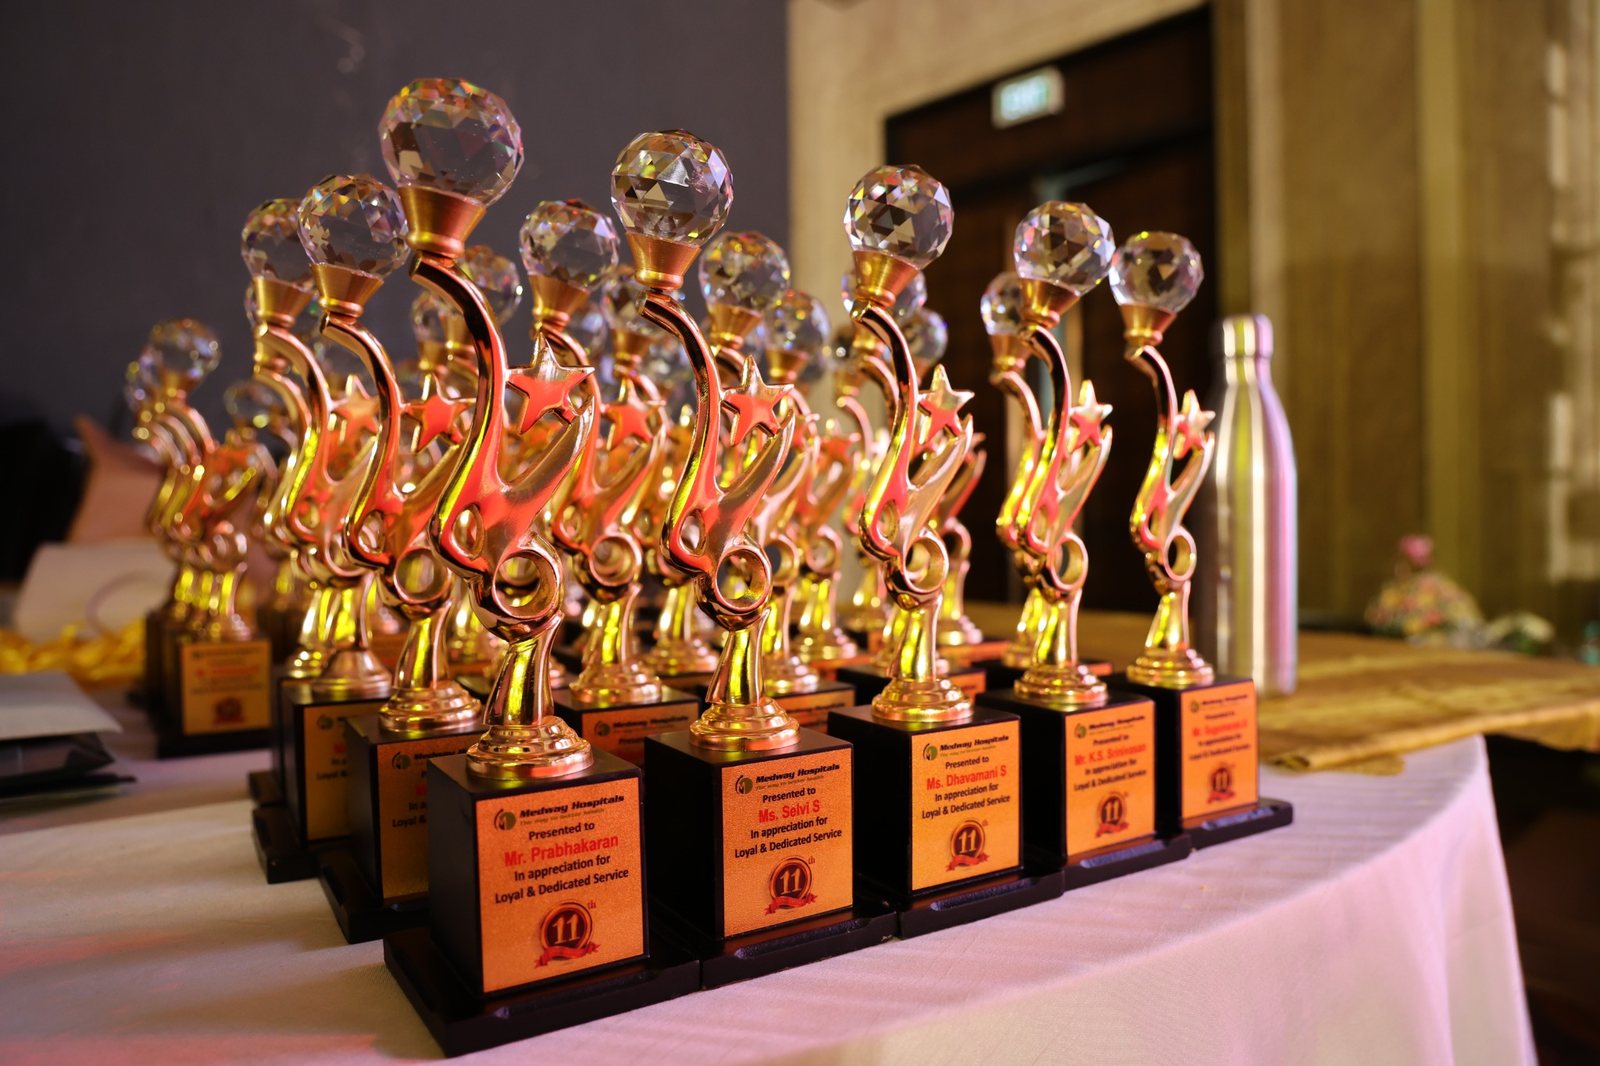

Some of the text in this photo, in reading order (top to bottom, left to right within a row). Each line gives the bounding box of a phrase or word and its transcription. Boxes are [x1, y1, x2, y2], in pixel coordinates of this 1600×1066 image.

[756, 764, 840, 783] Medway Hospitals
[945, 758, 980, 769] Presented
[927, 765, 1007, 790] Ms. Dhavamani S
[763, 787, 816, 803] Presented to
[935, 783, 999, 802] In appreciation for
[520, 795, 624, 818] Medway Hospitals
[759, 799, 820, 824] Ms. Selvi S
[922, 795, 1010, 819] Loyal & Dedicated Service
[529, 822, 595, 840] Presented to
[751, 816, 828, 839] In appreciation for
[504, 835, 619, 866] Mr. Prabhakaran
[735, 829, 842, 859] Loyal & Dedicated Service
[958, 829, 977, 854] 11
[515, 855, 611, 881] In appreciation for
[780, 867, 802, 893] 11
[495, 869, 628, 904] Loyal & Dedicated Service
[552, 914, 580, 944] 11
